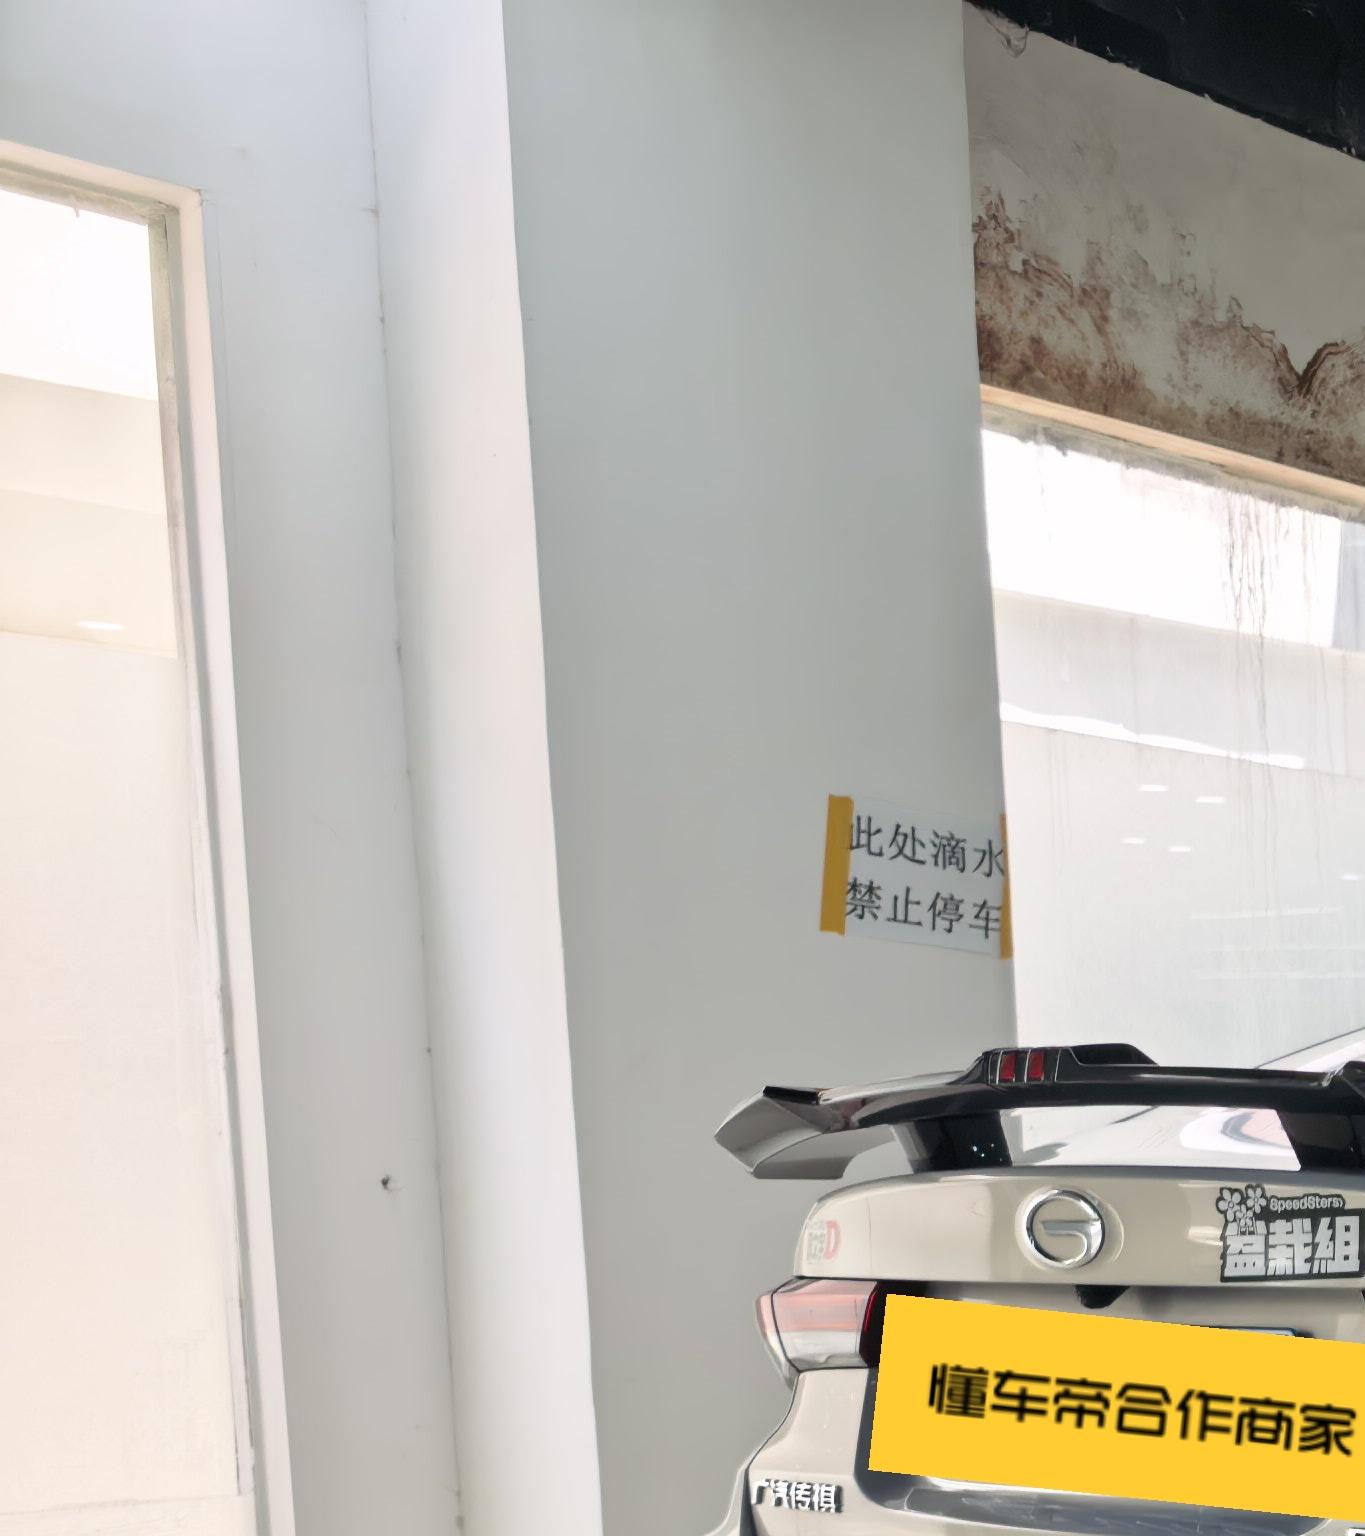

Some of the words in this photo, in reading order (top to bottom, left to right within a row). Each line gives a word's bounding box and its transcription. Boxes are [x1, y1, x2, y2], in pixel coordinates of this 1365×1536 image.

[848, 814, 1005, 878] 此处滴水
[846, 877, 1003, 940] 禁止停车
[750, 1478, 841, 1514] 广汽传祺
